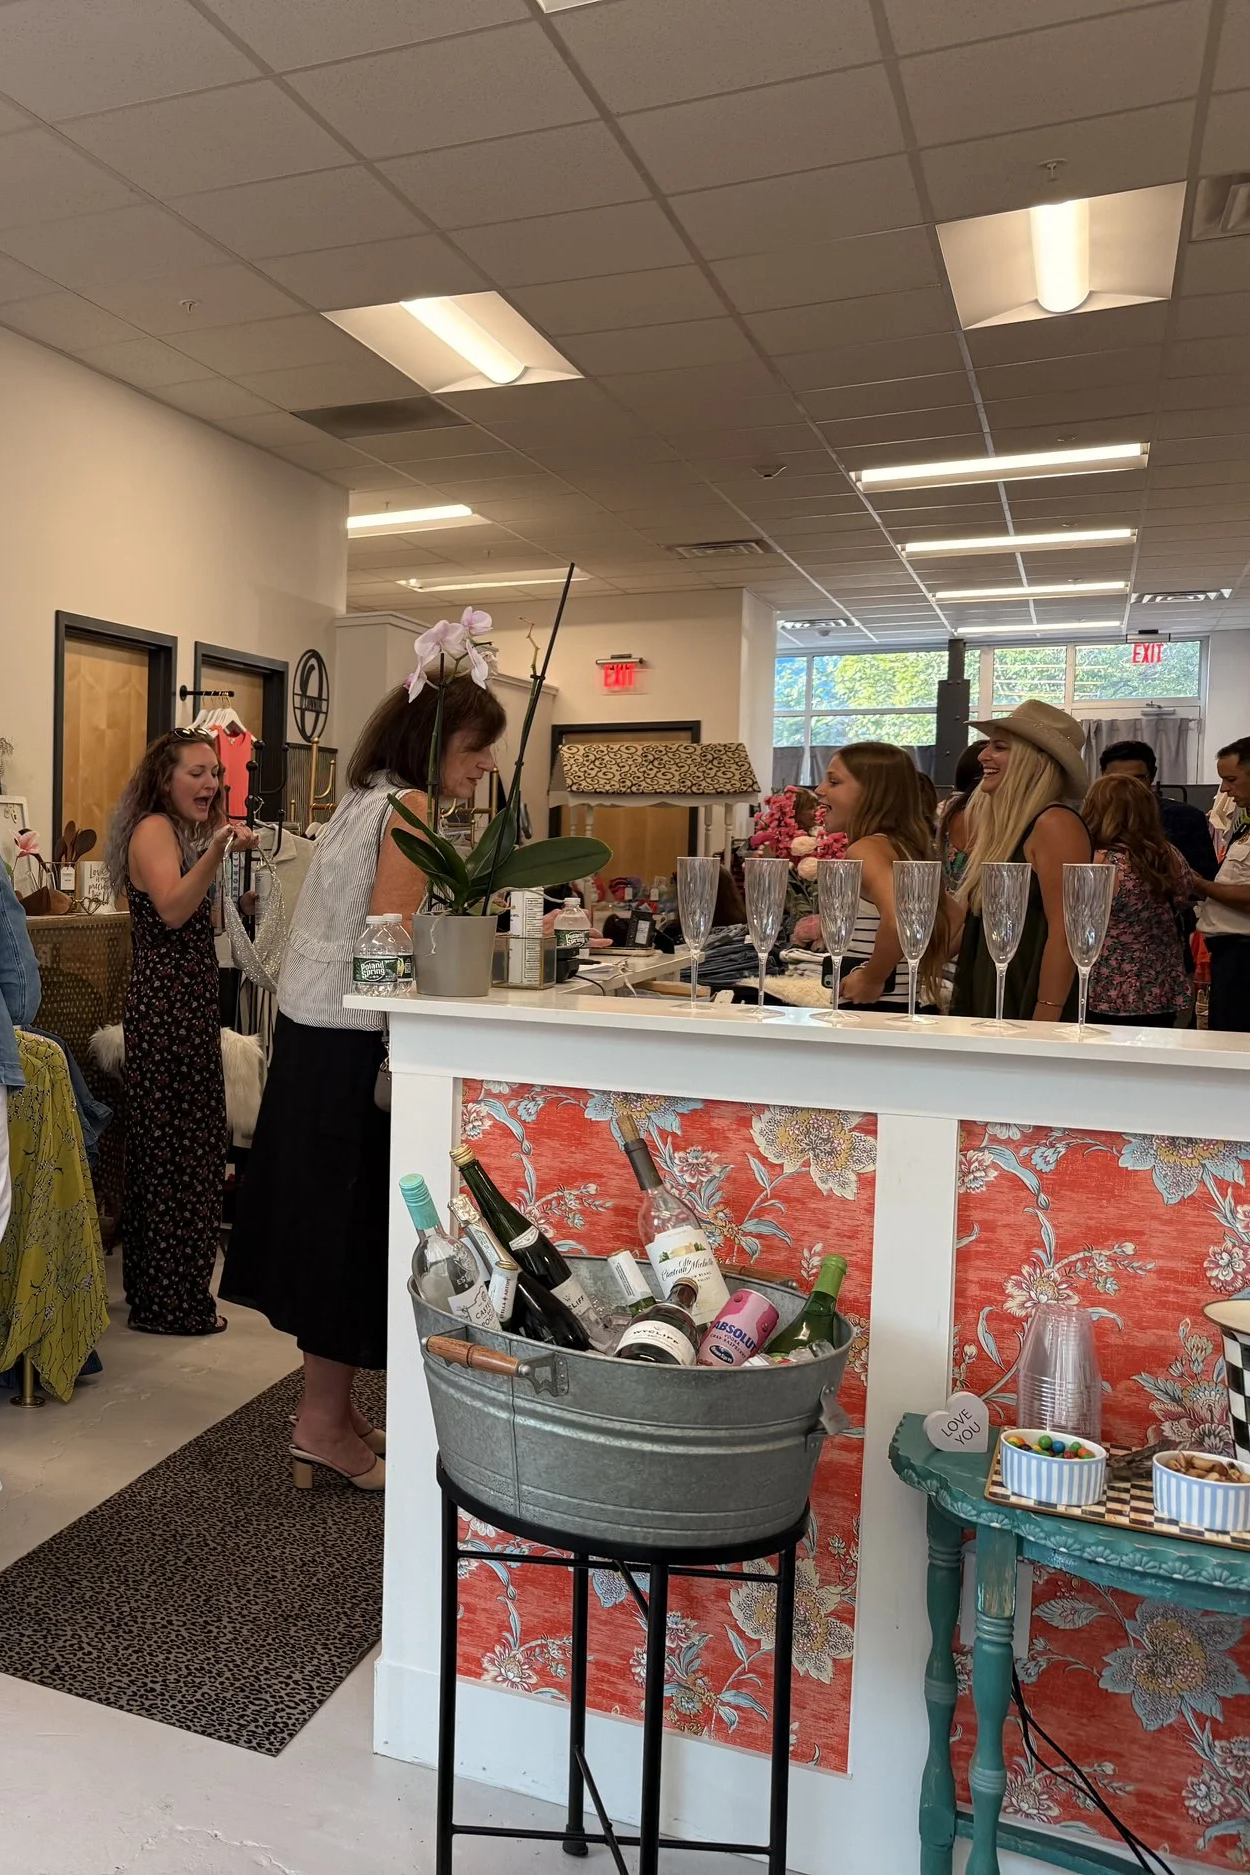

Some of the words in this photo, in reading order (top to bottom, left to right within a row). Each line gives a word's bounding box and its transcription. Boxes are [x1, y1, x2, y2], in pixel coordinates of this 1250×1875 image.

[1132, 642, 1164, 664] EXIT
[604, 663, 635, 688] EXIT
[361, 960, 385, 971] Poland
[361, 967, 386, 979] Spring
[713, 1320, 757, 1351] ABSOLUT
[941, 1409, 972, 1437] LOVE
[954, 1421, 981, 1445] YOU
